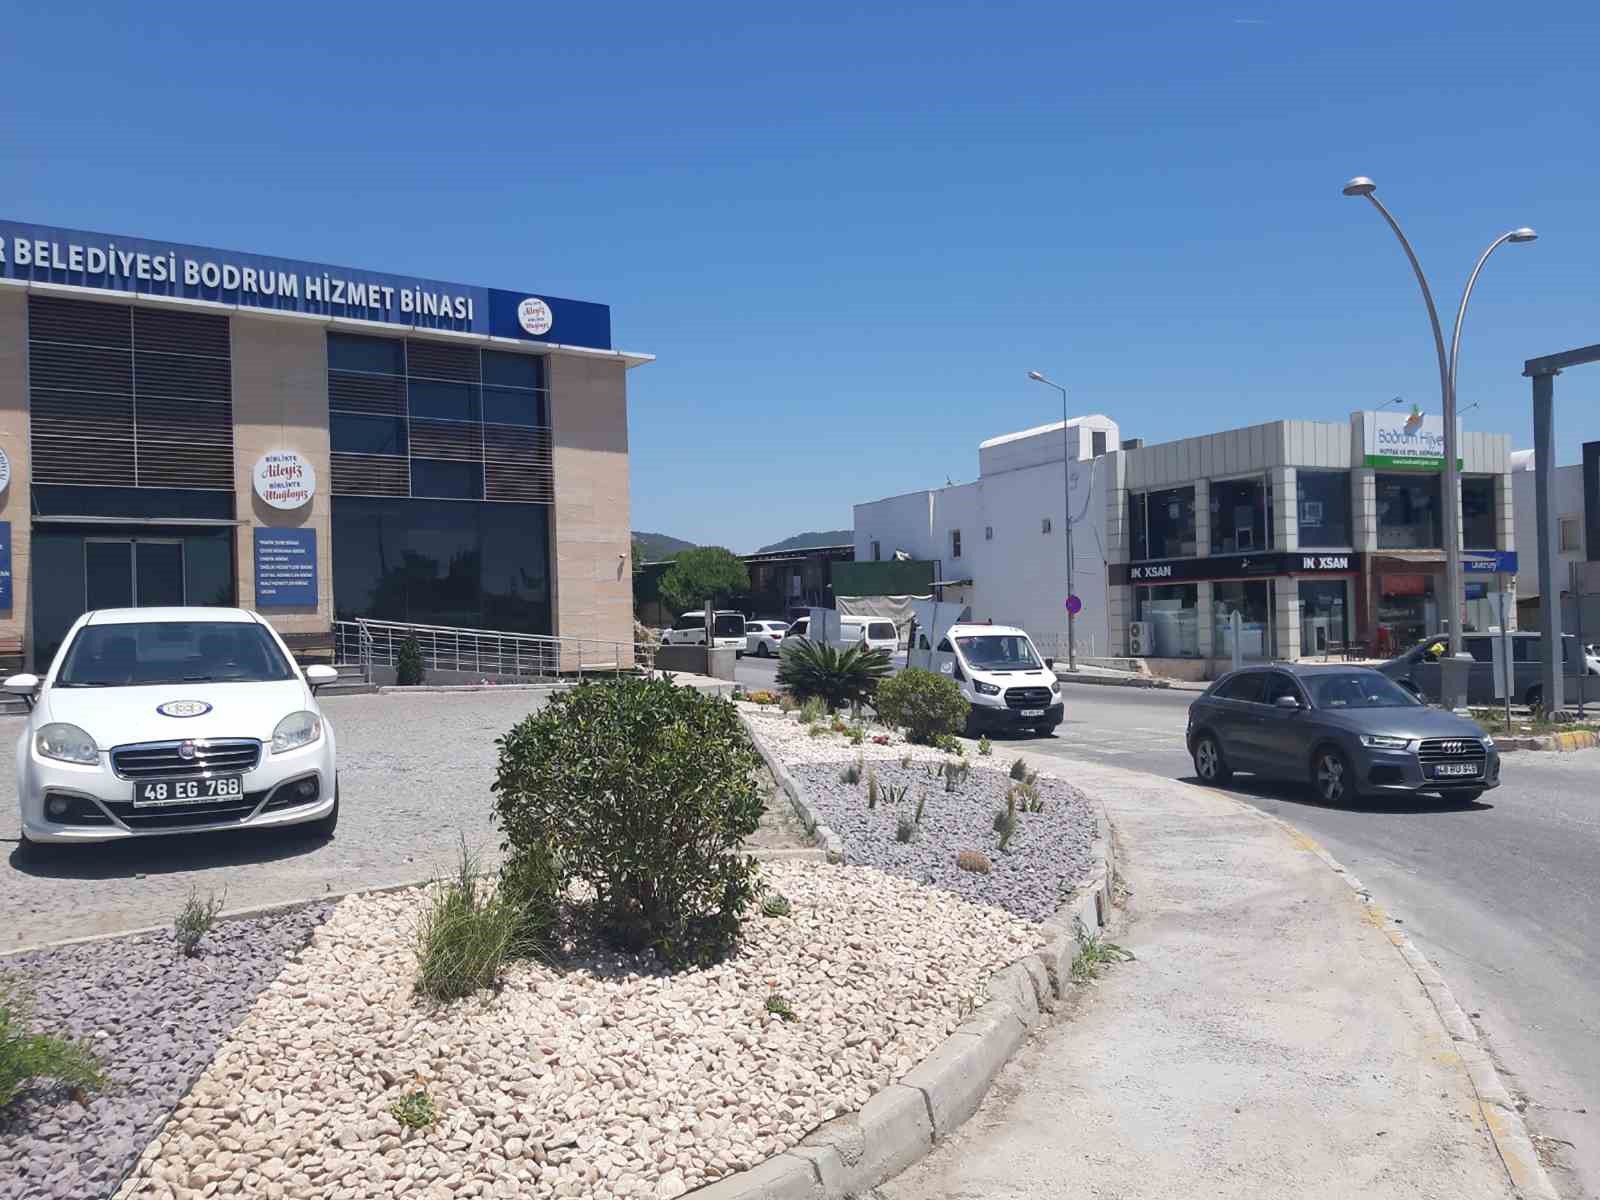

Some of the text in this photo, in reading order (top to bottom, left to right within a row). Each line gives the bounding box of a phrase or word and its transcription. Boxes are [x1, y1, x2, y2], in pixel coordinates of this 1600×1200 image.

[14, 238, 176, 283] BELEDİYESİ
[184, 259, 299, 298] BODRUM
[305, 272, 395, 310] HİZMET
[400, 285, 473, 320] BİNASI
[1378, 428, 1442, 449] Bodrum Hijye
[144, 778, 239, 800] 48 EG 768
